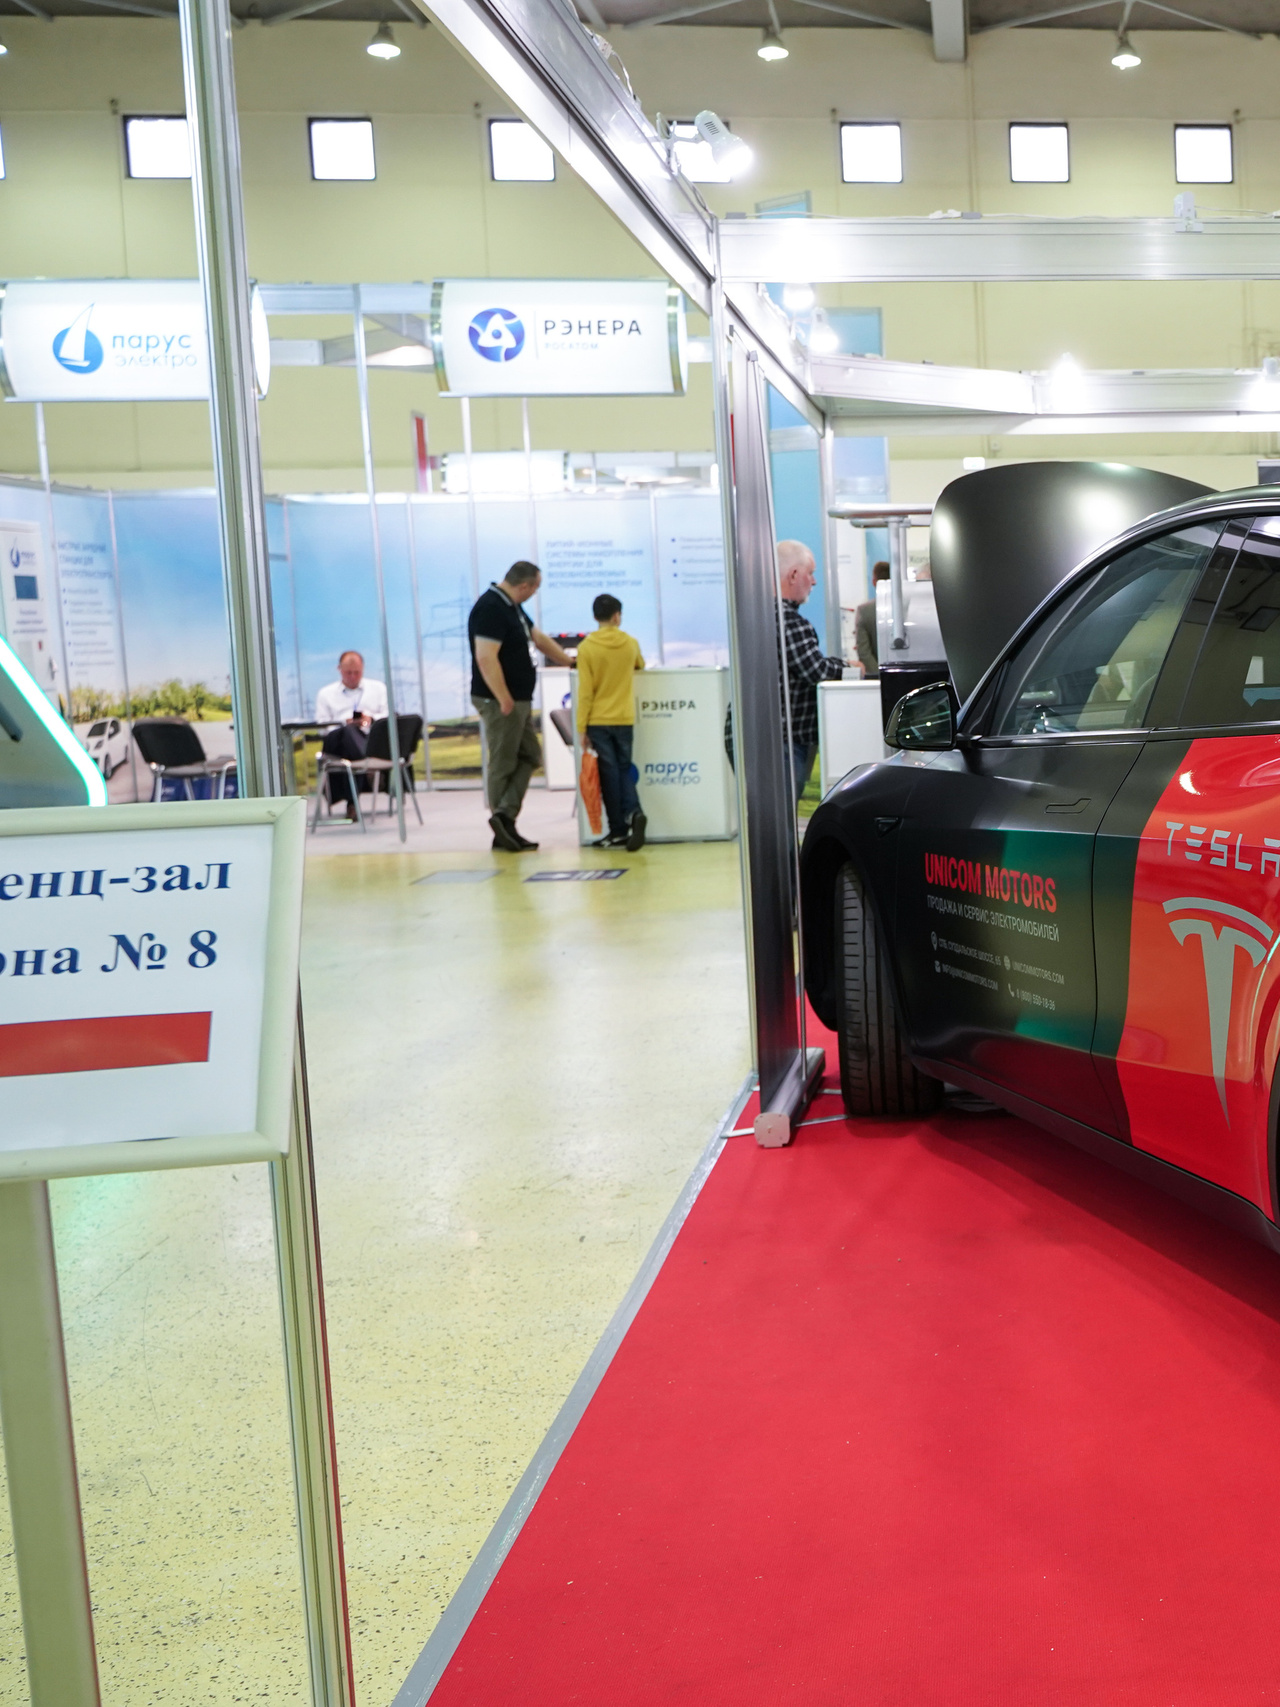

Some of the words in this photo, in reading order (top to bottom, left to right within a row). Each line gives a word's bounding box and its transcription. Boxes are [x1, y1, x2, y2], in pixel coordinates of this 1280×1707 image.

[543, 319, 642, 336] РЭНЕРА
[112, 334, 192, 353] парус
[114, 353, 198, 369] электро
[641, 699, 696, 711] РЭНЕРА
[644, 761, 699, 777] парус
[925, 852, 982, 895] UNICOM
[985, 864, 1057, 913] MOTORS
[927, 894, 958, 914] ПРОДАЖА
[957, 902, 963, 917] И
[964, 904, 989, 924] СЕРВИС
[990, 911, 1060, 942] ЭЛЕКТРОМОБИЛЕЙ
[0, 947, 82, 976] на
[187, 929, 218, 969] 8
